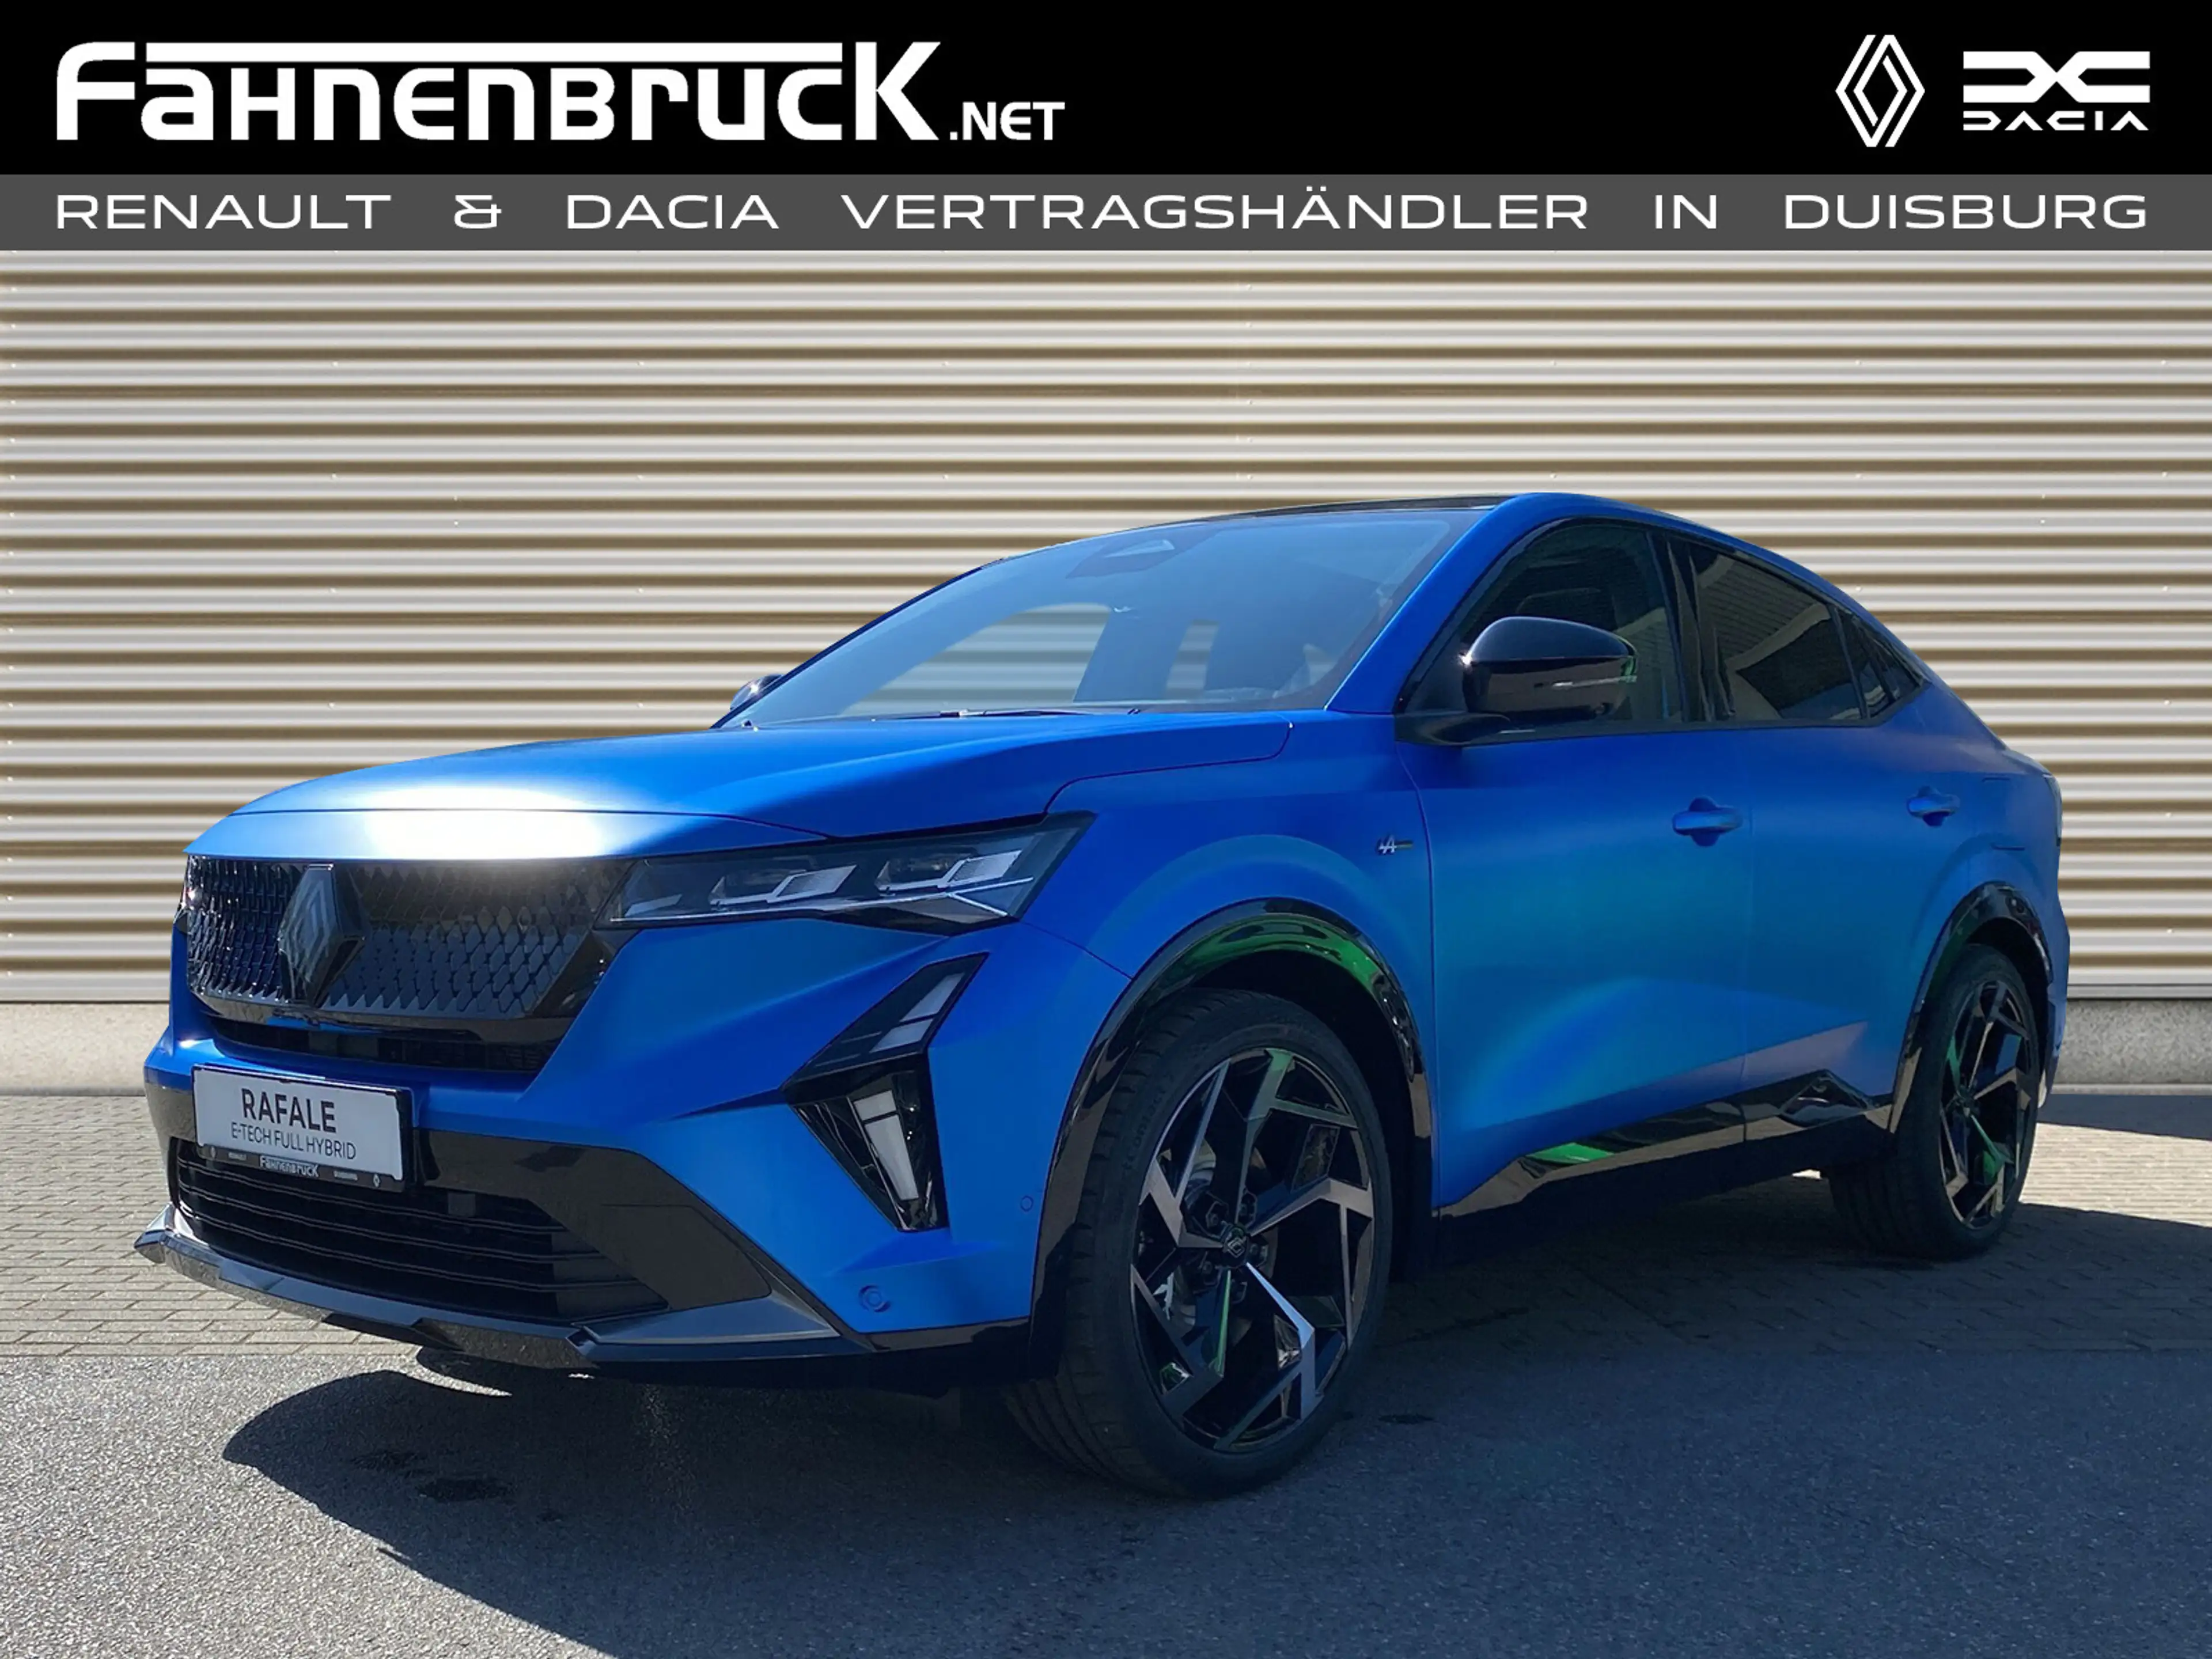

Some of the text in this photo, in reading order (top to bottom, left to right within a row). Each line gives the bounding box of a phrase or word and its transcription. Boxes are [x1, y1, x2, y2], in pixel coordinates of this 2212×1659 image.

[241, 1088, 336, 1133] RAFALE
[231, 1122, 357, 1160] E-TECH FULL HYBRID
